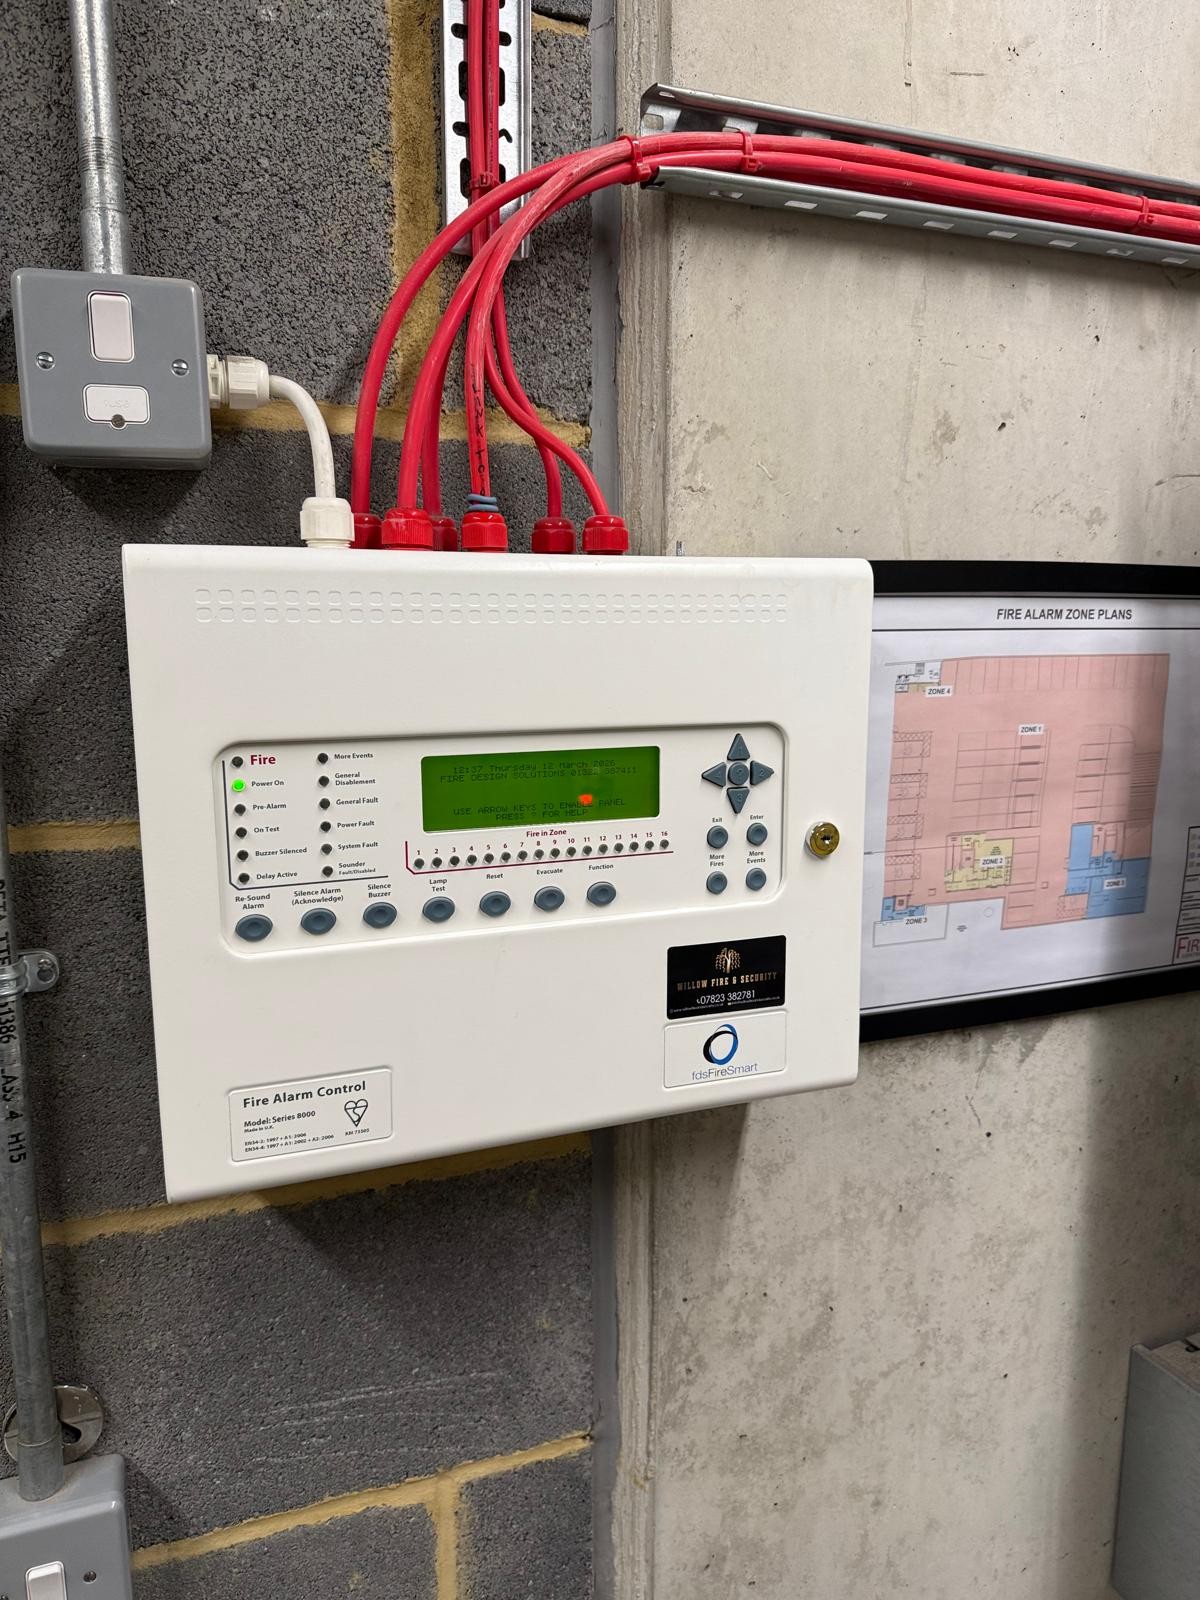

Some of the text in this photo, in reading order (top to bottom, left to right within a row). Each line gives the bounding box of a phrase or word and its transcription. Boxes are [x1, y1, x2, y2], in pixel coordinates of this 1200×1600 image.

[997, 609, 1132, 620] FIRE ALARM ZONE PLANS
[250, 755, 276, 765] Fire
[441, 775, 464, 783] FIRE
[280, 847, 307, 855] Silenced
[256, 873, 275, 881] Delay
[235, 894, 270, 902] Re-Sound
[292, 895, 344, 906] (Acknowledge)
[677, 980, 707, 991] WILLOW
[712, 977, 728, 987] FIRE
[741, 972, 777, 983] SECURITY
[700, 995, 725, 1004] 07823
[727, 990, 755, 1001] 382781
[692, 1063, 758, 1080] fdsFireSmart
[243, 1081, 366, 1108] Fire Alarm Control
[244, 1111, 316, 1127] Model: Series 8000
[8, 1132, 27, 1163] H15
